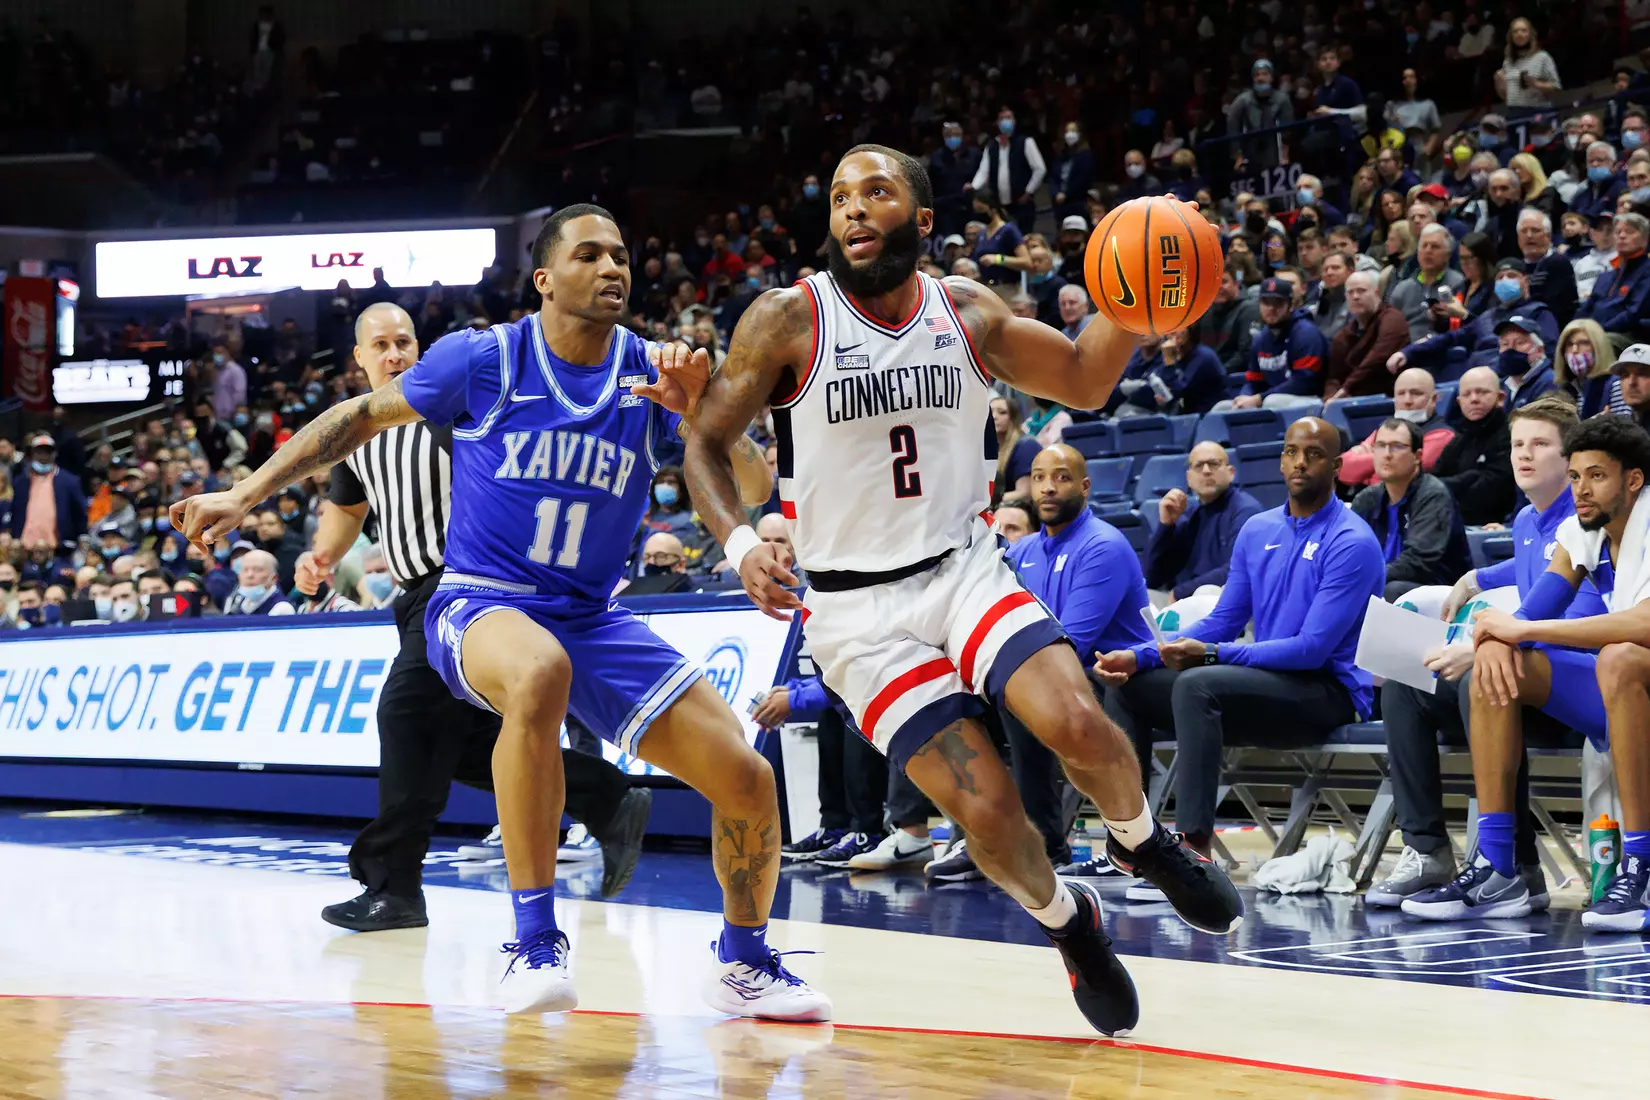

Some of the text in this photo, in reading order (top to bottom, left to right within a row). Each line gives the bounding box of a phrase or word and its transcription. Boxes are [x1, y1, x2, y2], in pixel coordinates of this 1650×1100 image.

[1260, 162, 1302, 196] 120
[188, 256, 262, 279] LAZ
[311, 252, 364, 268] LAZ
[1159, 235, 1181, 308] ELITE
[934, 338, 957, 347] EAST
[158, 359, 191, 376] MI
[826, 365, 962, 424] CONNECTICUT
[494, 430, 636, 499] XAVIER
[889, 424, 922, 499] 2
[526, 496, 590, 569] 11
[56, 664, 171, 731] SHOT.
[174, 661, 275, 732] GET
[277, 659, 386, 733] THE
[1593, 840, 1615, 865] G
